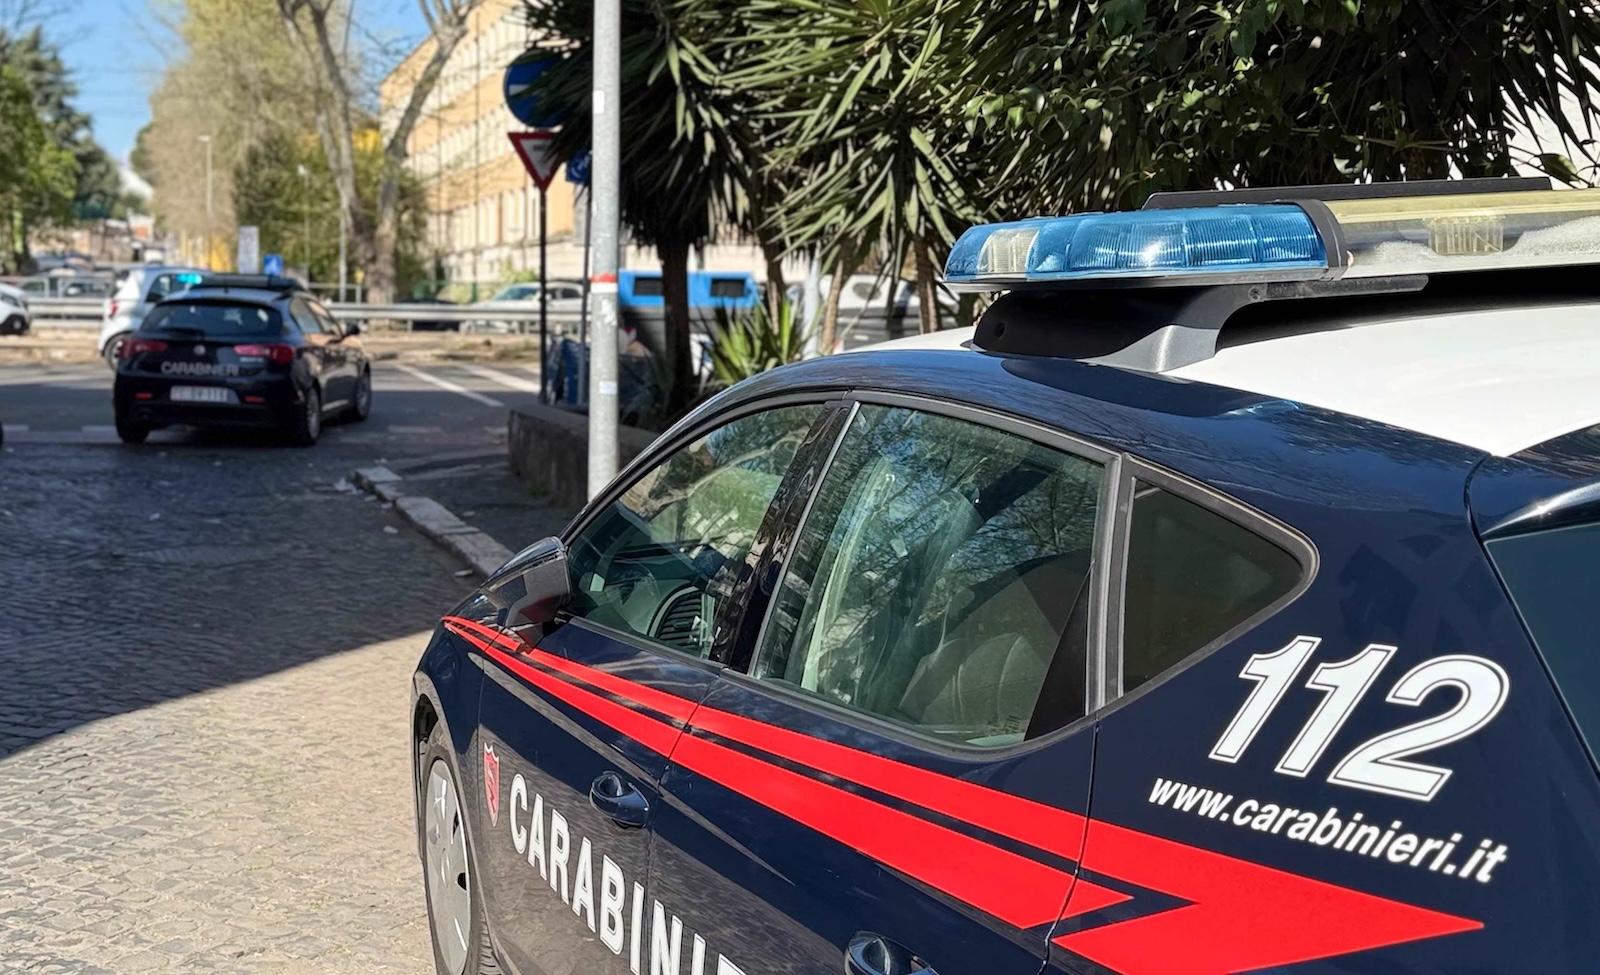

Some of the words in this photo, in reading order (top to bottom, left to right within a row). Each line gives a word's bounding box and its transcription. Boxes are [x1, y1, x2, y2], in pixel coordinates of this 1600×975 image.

[160, 361, 240, 376] CARABINIERI
[1208, 635, 1510, 802] 112
[509, 773, 750, 975] CARABIN
[1148, 777, 1508, 884] www.carabinieri.it
